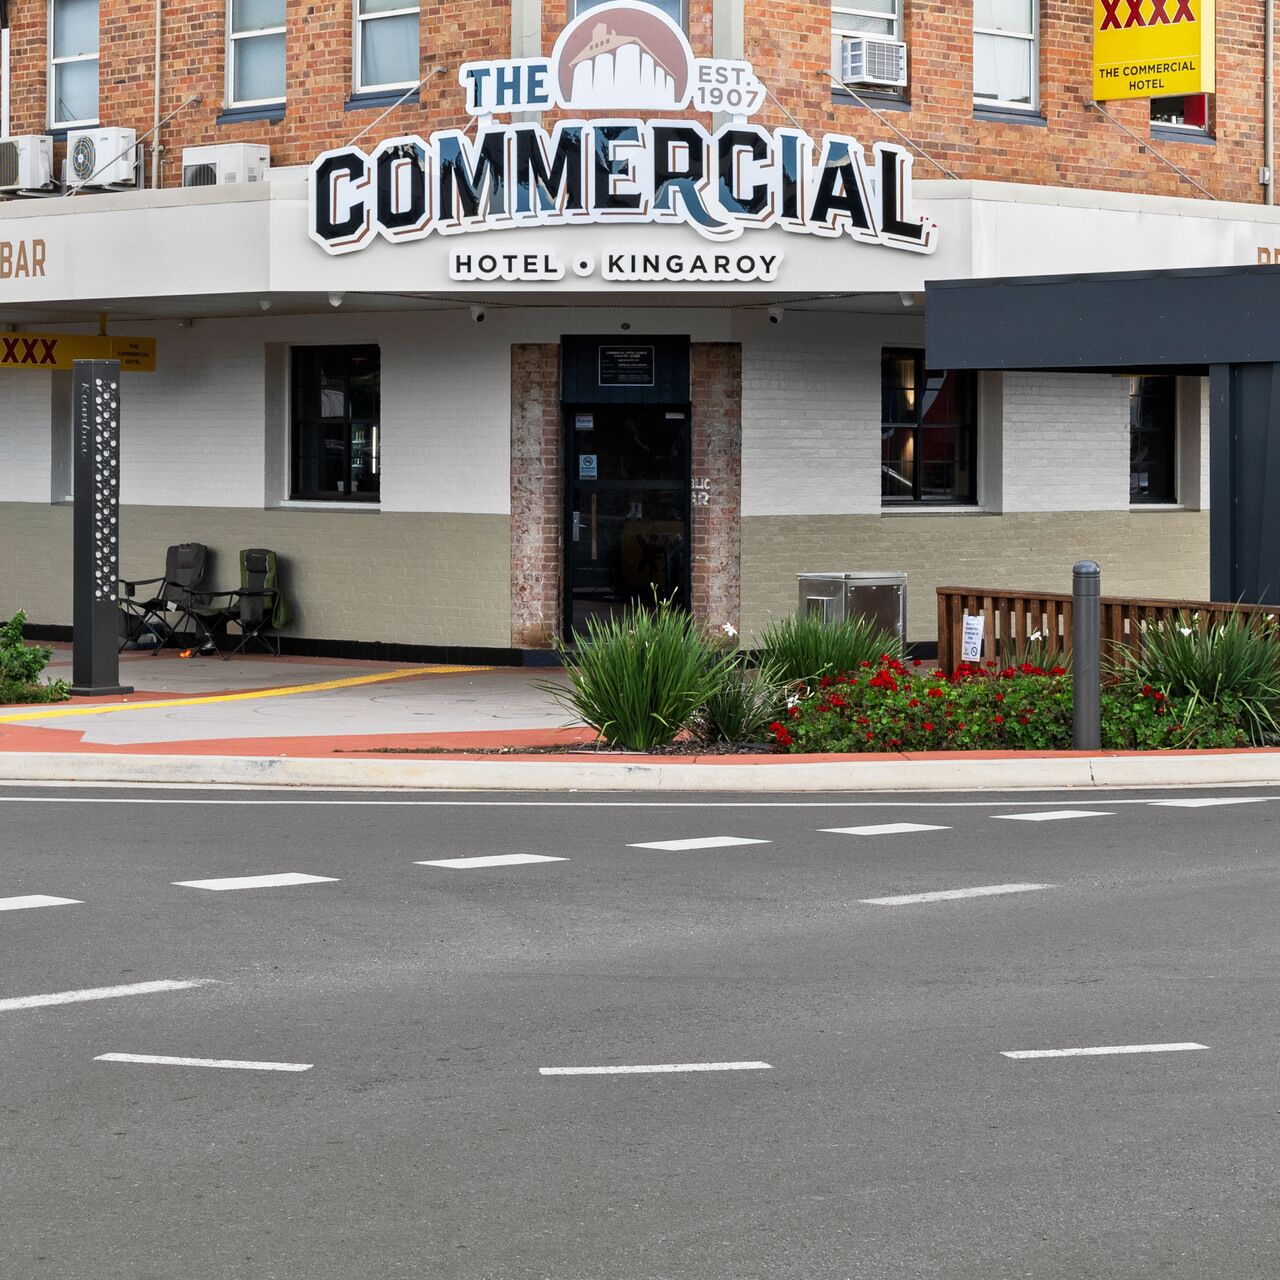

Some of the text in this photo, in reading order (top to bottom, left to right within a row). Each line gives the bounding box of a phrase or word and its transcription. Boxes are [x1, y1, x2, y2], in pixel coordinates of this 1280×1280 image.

[698, 65, 752, 86] EST.
[1099, 60, 1196, 79] THE COMMERCIAL
[467, 64, 549, 107] THE
[1129, 78, 1165, 91] HOTEL
[698, 86, 759, 107] 1907
[316, 125, 930, 247] COMMERCIAL
[0, 239, 46, 279] BAR
[455, 254, 776, 274] HOTEL KINGAROY
